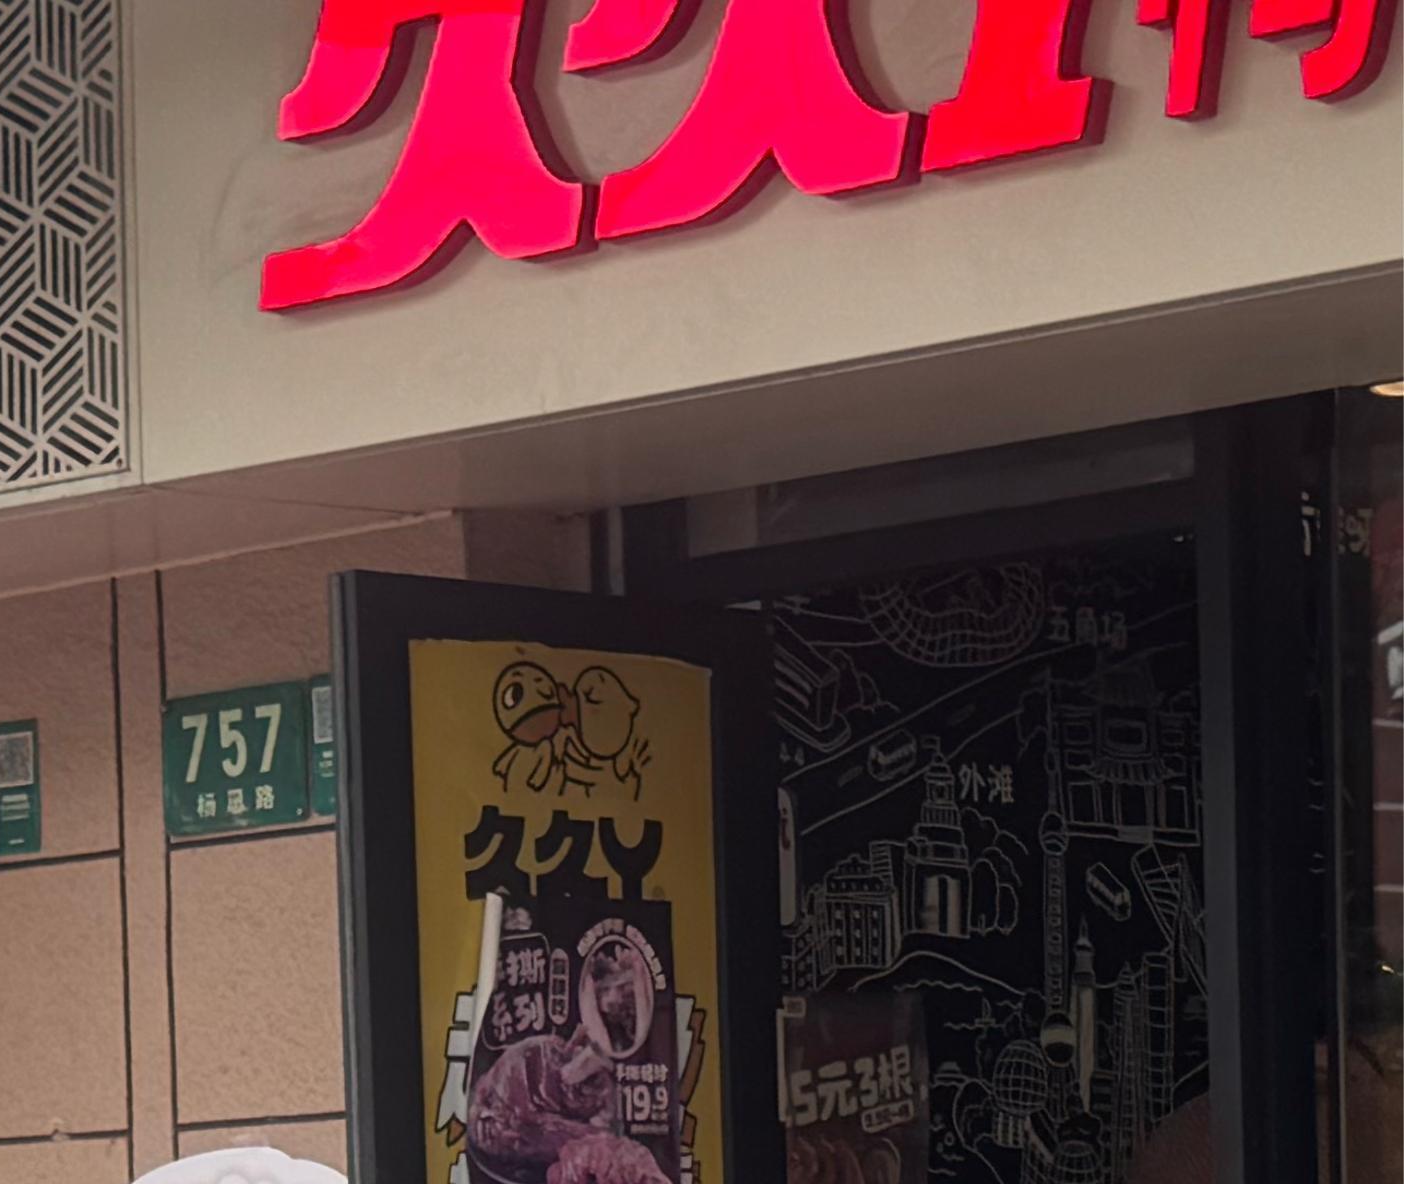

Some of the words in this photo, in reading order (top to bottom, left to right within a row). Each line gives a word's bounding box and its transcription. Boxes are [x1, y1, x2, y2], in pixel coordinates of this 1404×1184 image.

[181, 703, 283, 784] 757
[197, 784, 276, 819] 杨思路
[959, 764, 1016, 805] 外滩
[496, 947, 547, 987] 撕
[791, 1045, 915, 1127] 5元3根
